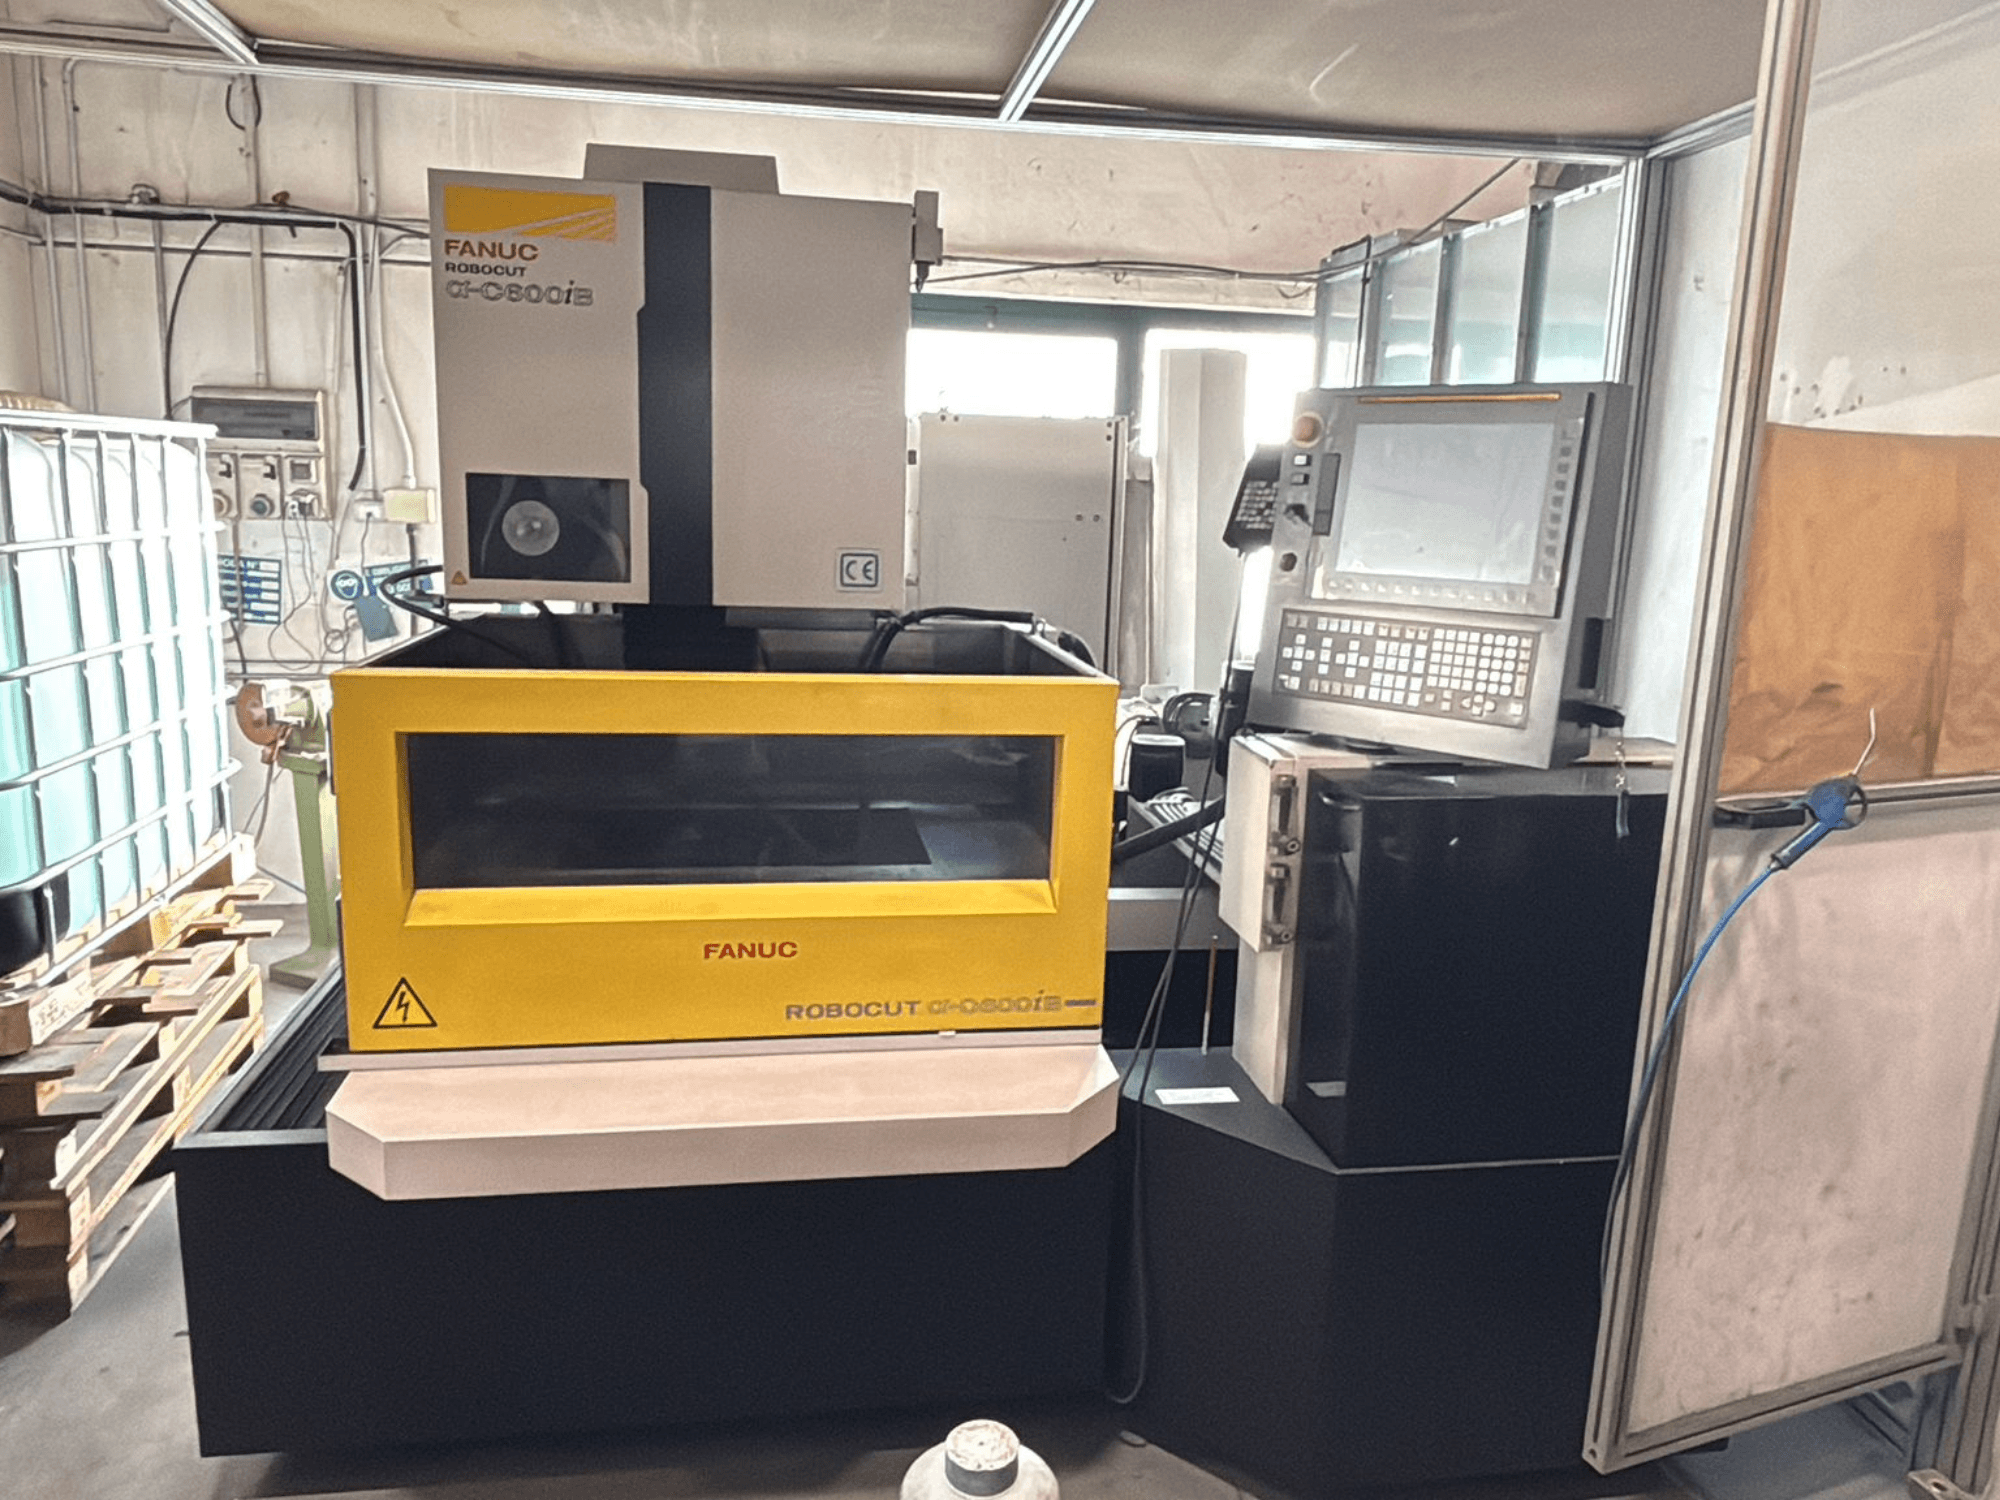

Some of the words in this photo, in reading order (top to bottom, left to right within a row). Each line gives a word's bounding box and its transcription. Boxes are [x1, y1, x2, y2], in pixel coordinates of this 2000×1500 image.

[444, 239, 539, 261] FANUC
[445, 262, 526, 277] ROBOCUT
[845, 560, 874, 581] CE
[704, 941, 798, 959] FANUC
[786, 1000, 921, 1021] ROBOCUT
